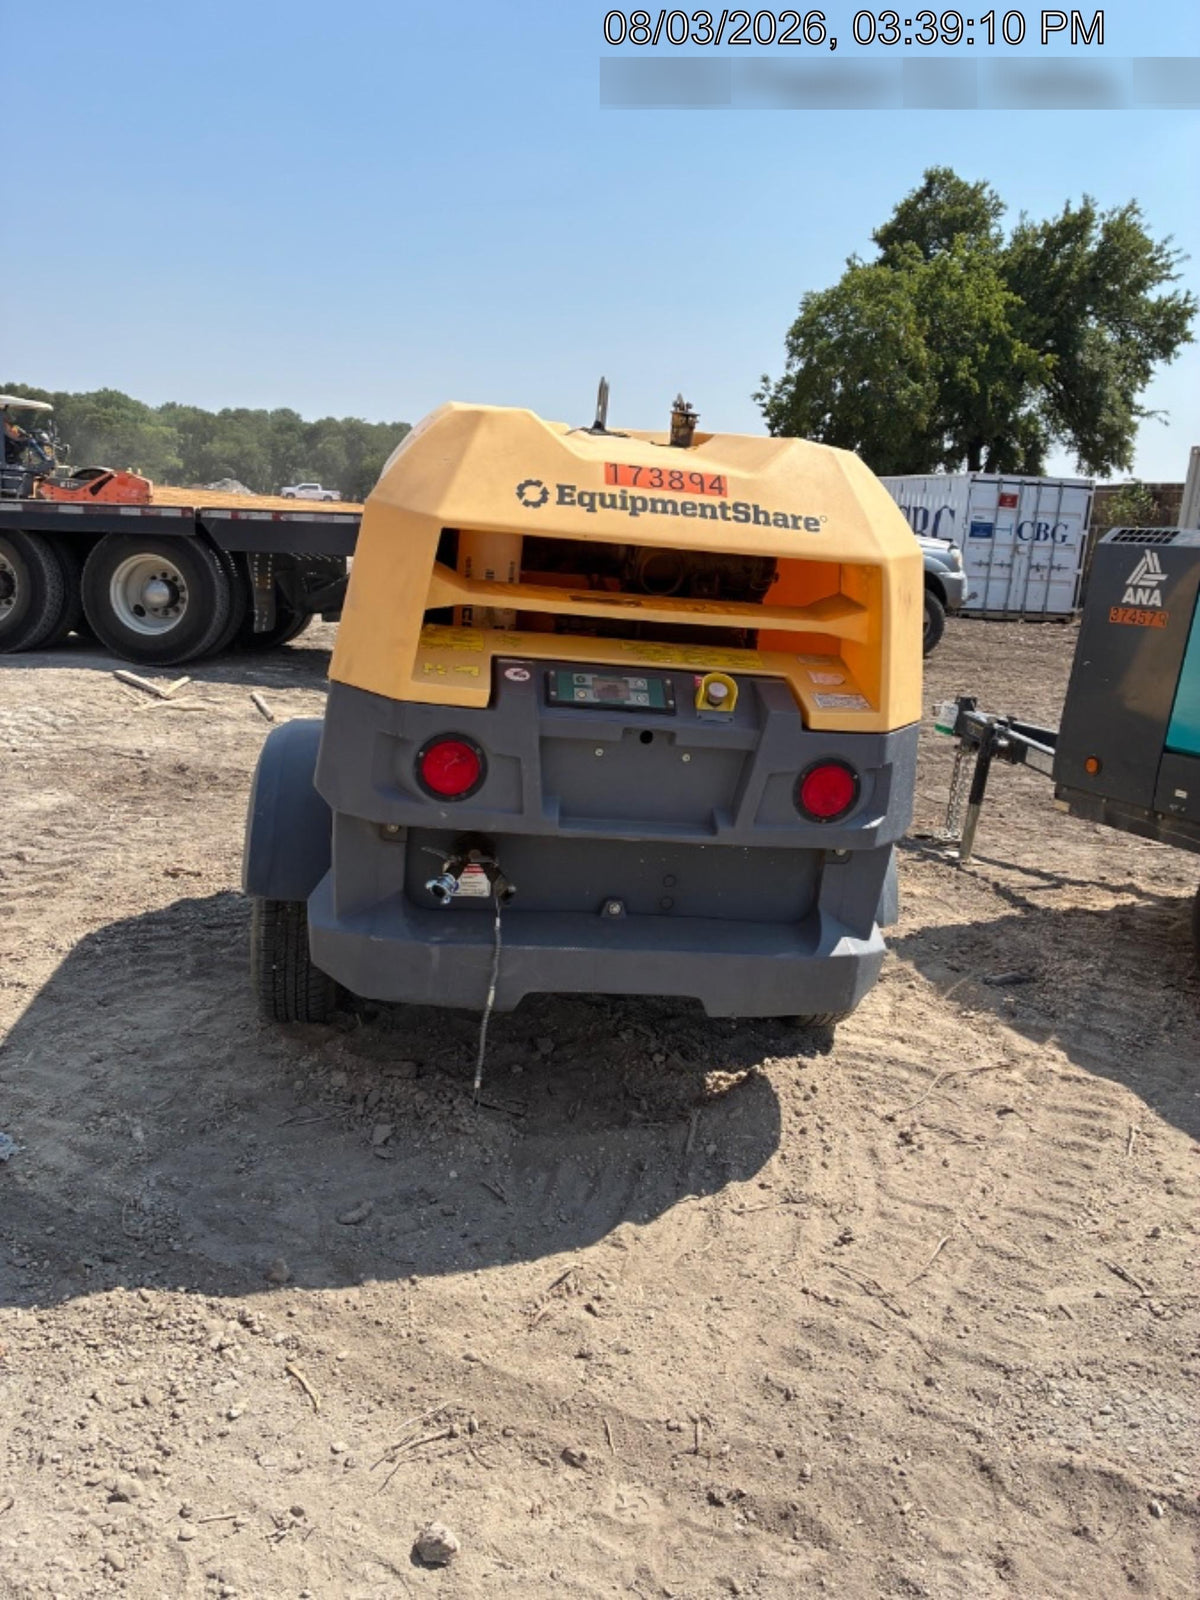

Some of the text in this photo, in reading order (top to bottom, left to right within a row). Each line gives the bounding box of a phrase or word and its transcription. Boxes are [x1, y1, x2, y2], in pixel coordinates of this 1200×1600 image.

[609, 463, 724, 495] 173894
[556, 483, 820, 532] EquipmentShare
[1017, 521, 1069, 544] CBG
[1121, 586, 1162, 607] ANA
